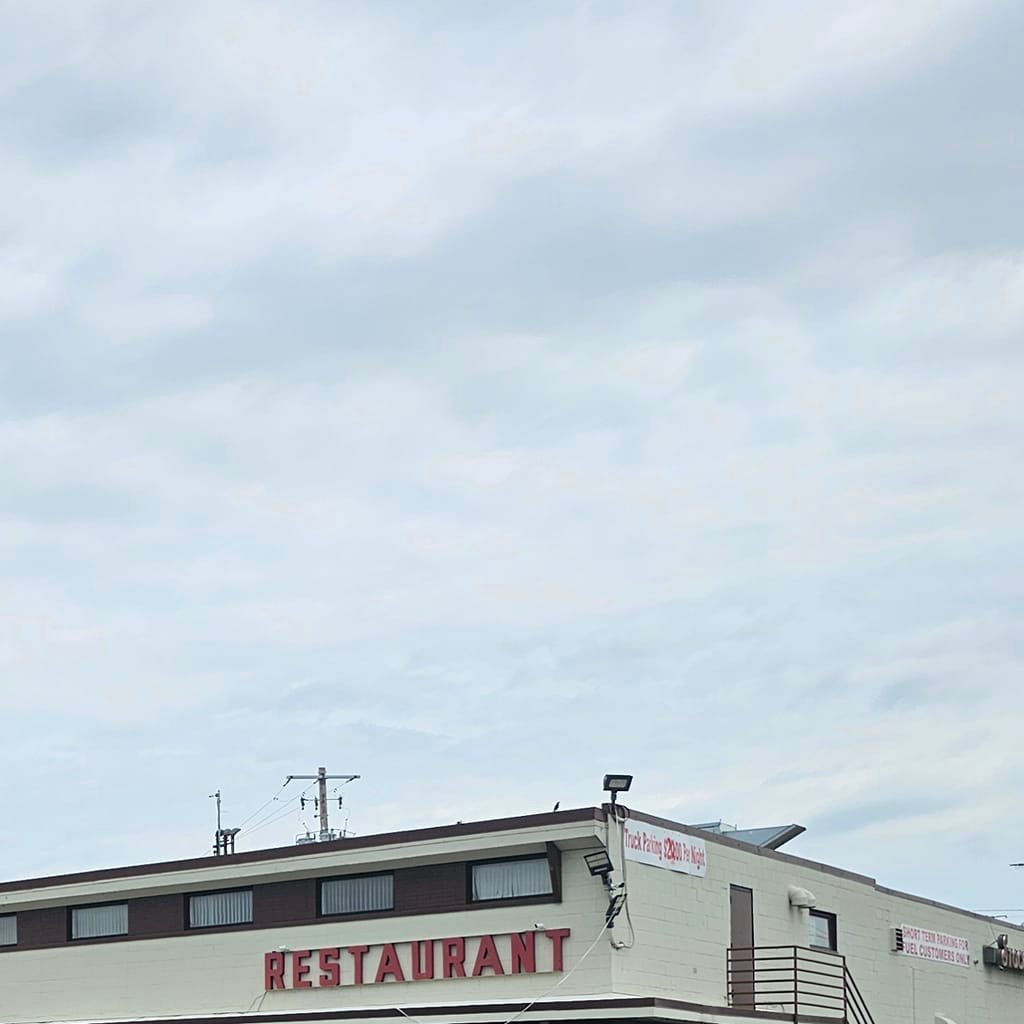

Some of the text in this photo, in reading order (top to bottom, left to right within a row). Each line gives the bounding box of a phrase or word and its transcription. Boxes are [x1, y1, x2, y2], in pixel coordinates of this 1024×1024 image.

[624, 828, 641, 851] Truck
[643, 832, 662, 860] Parking
[691, 845, 705, 869] Night
[919, 944, 954, 962] CUSTOMERS
[956, 952, 969, 965] ONLY
[922, 931, 935, 944] TERM
[937, 933, 957, 949] PARKING
[959, 939, 968, 951] FOR
[264, 928, 571, 991] RESTAURANT
